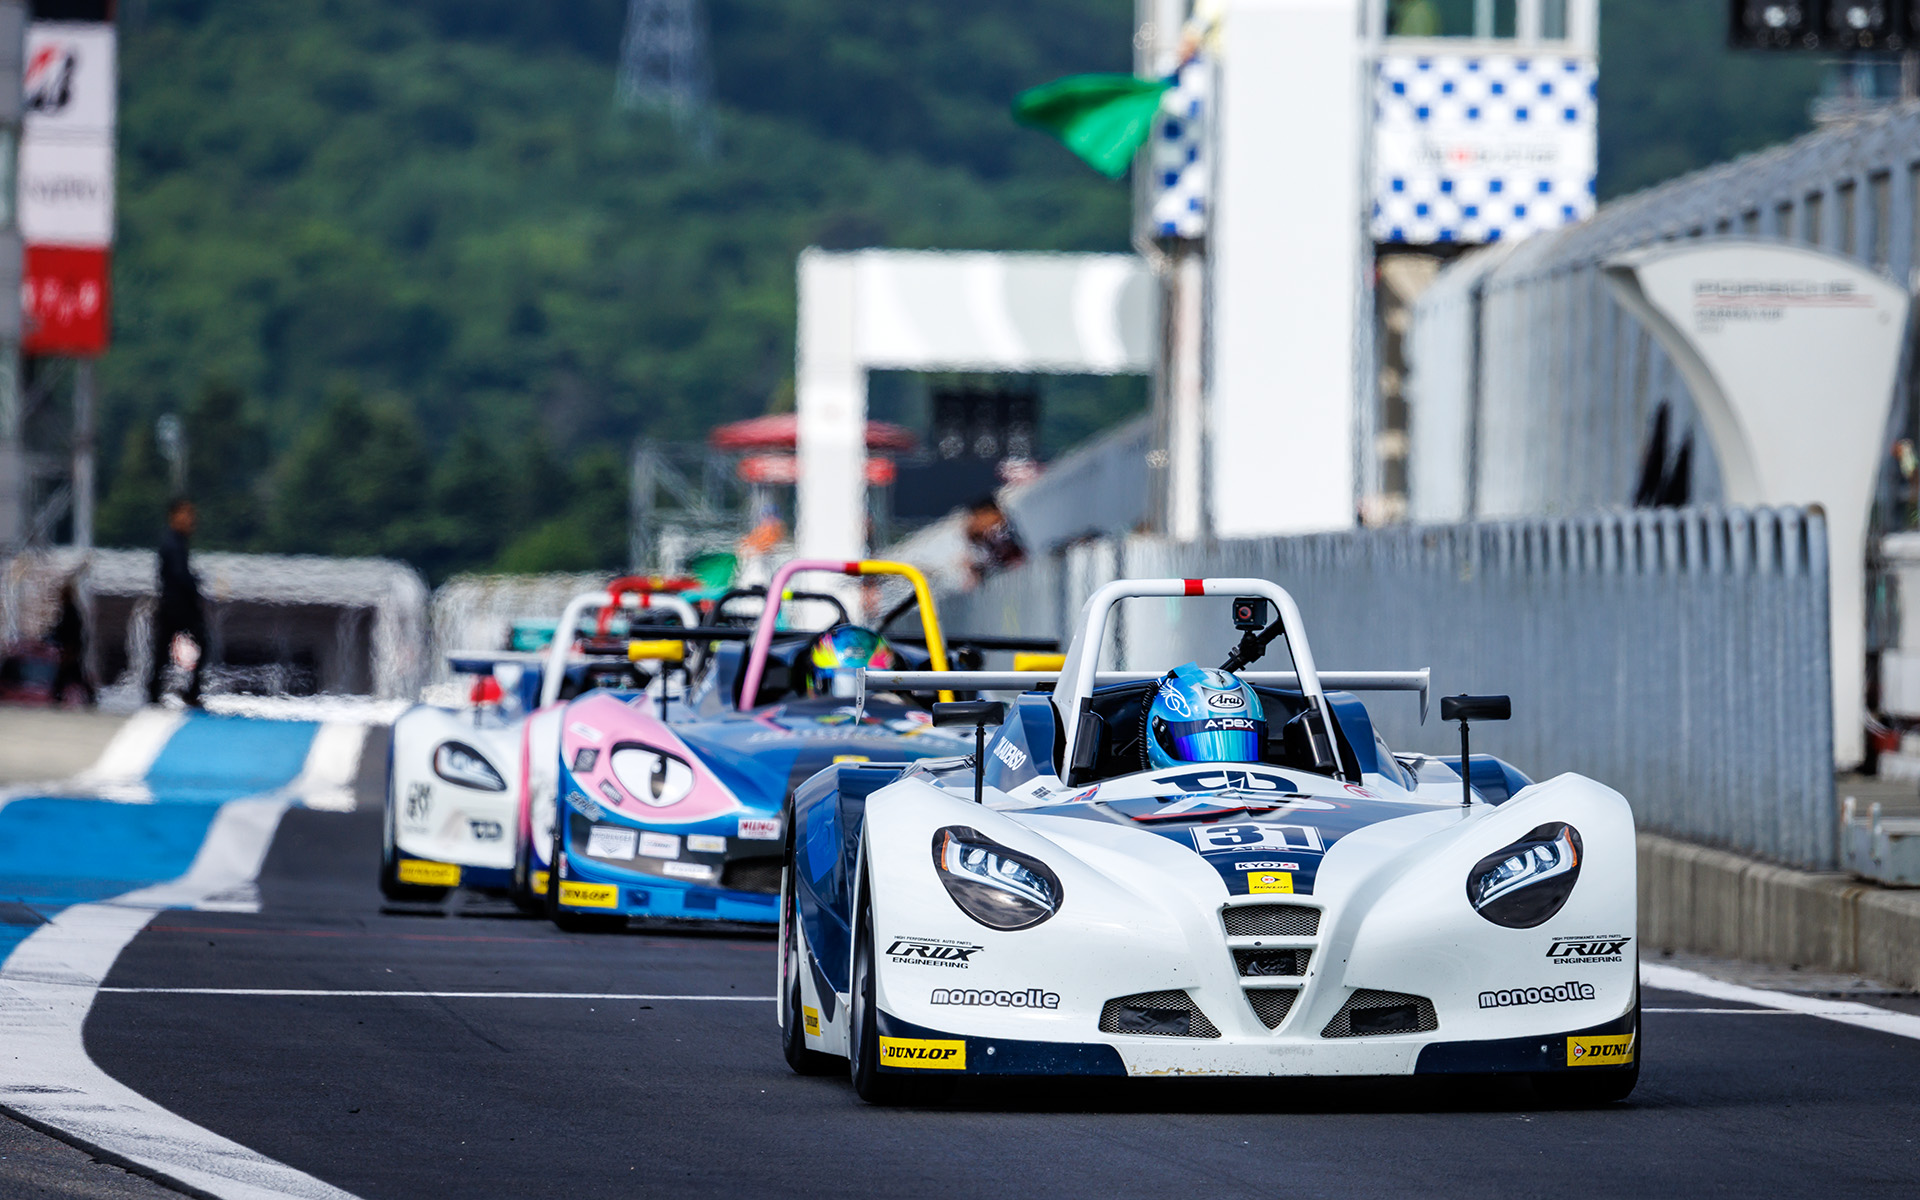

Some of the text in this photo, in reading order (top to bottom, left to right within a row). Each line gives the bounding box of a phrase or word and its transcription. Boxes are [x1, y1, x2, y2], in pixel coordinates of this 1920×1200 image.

[1212, 694, 1240, 705] Arai
[1206, 824, 1310, 847] 31
[892, 957, 969, 969] ENGINEERING
[1553, 956, 1622, 965] ENGINEERING
[930, 988, 1060, 1009] monocolle
[1478, 981, 1595, 1009] monocolle
[888, 1046, 957, 1060] DUNLOP
